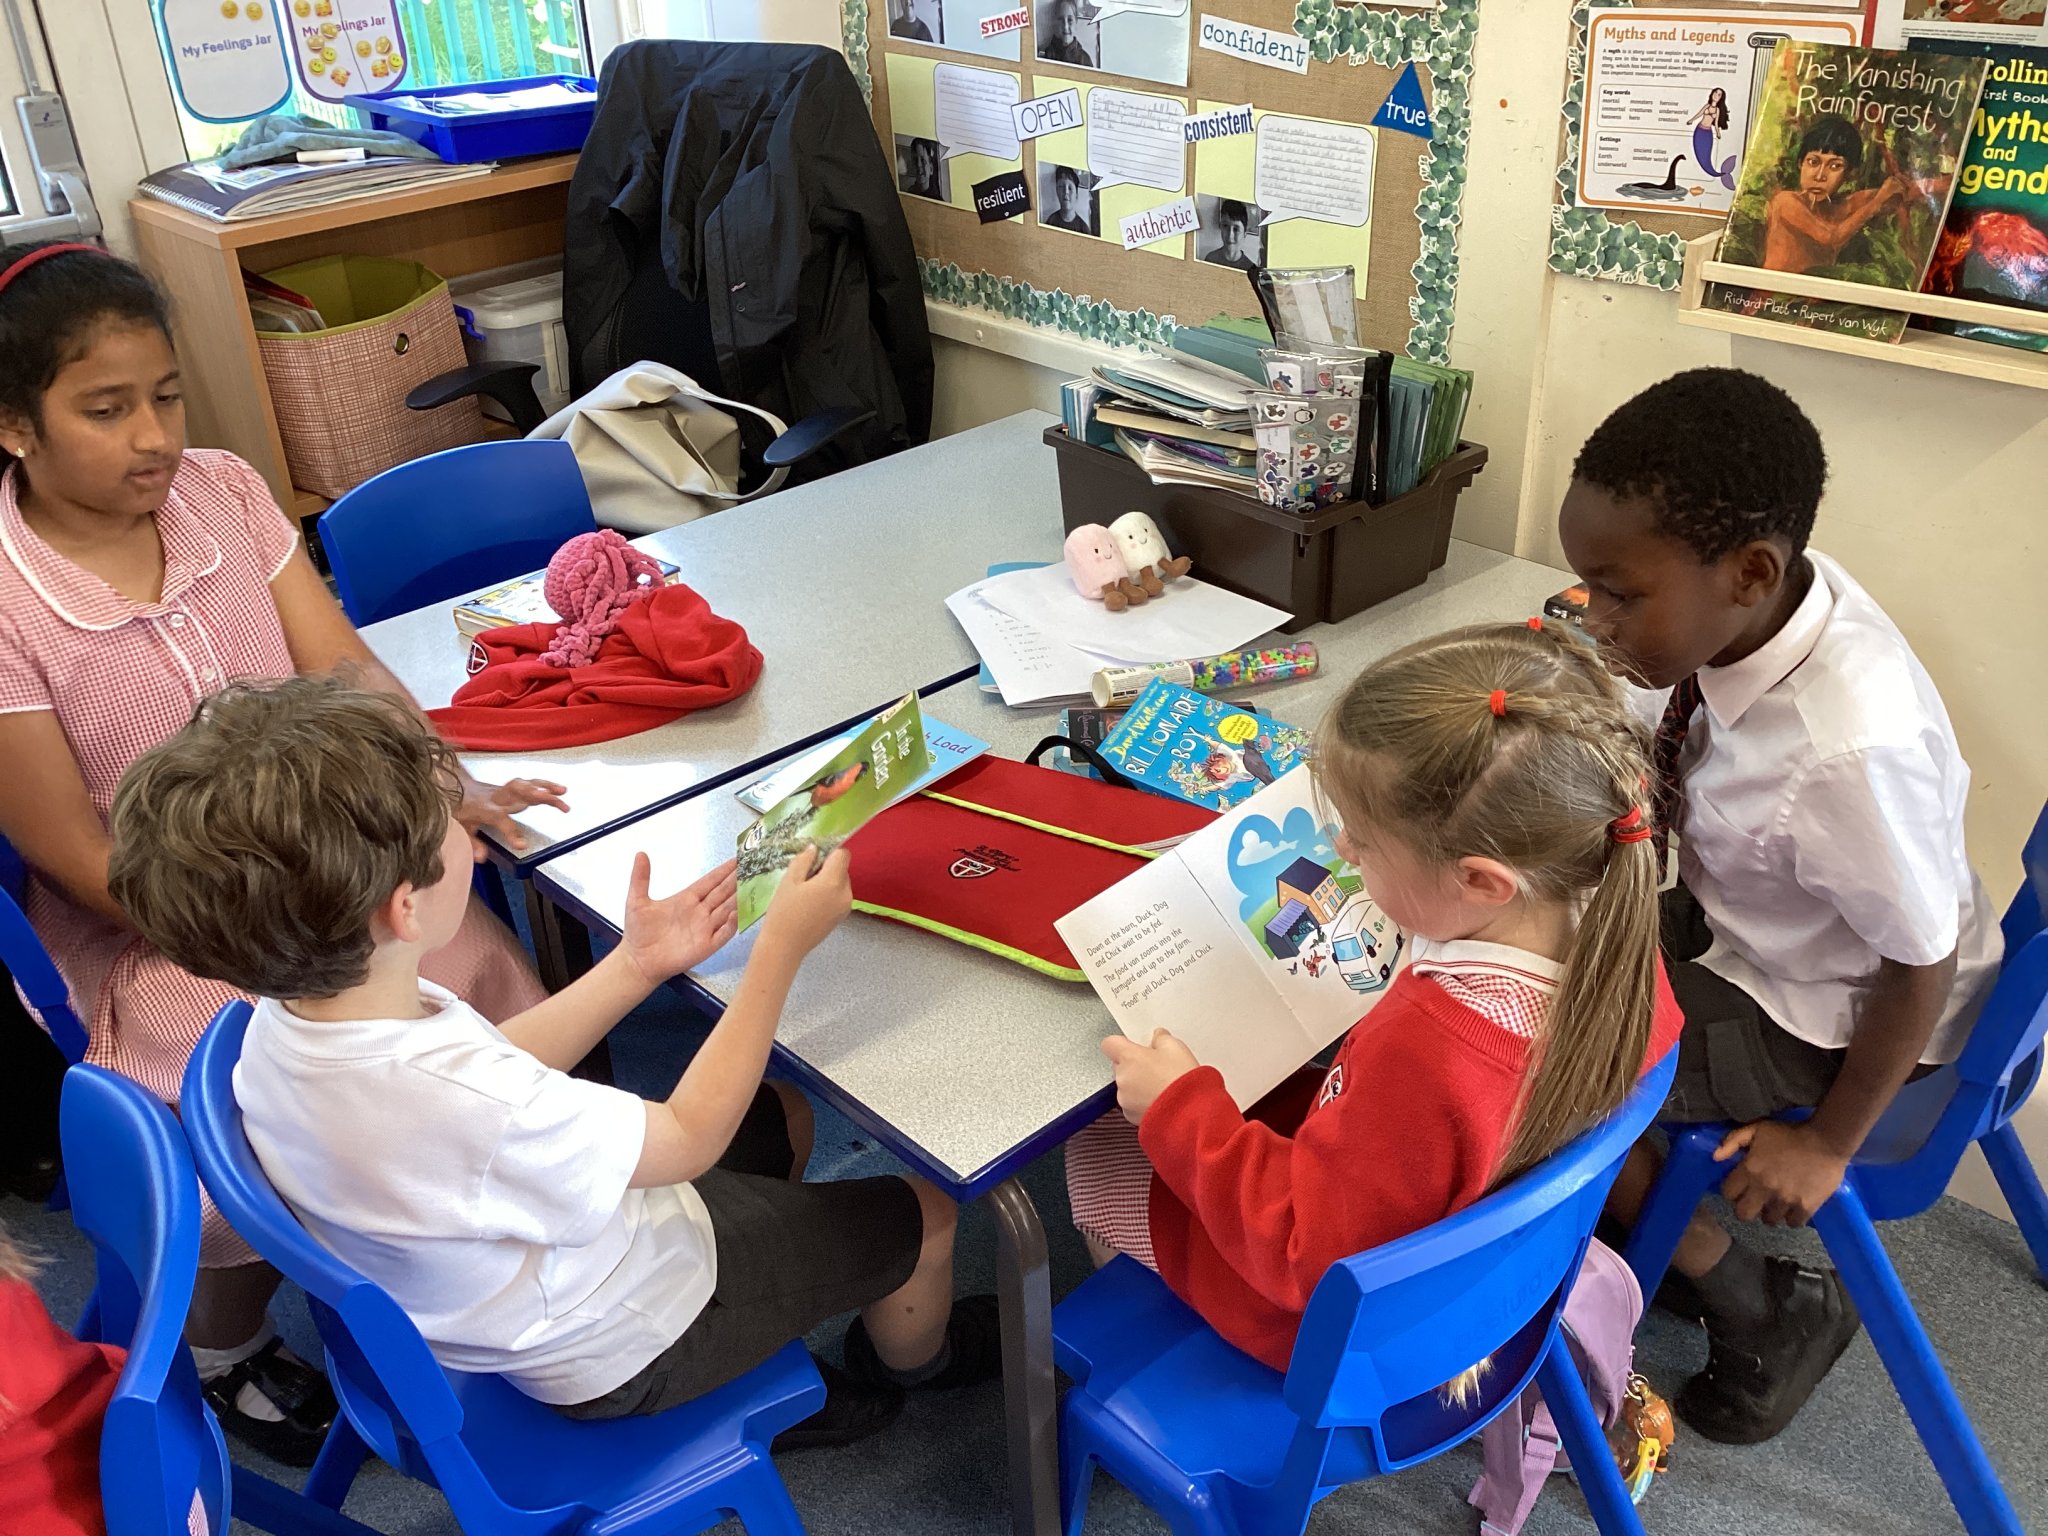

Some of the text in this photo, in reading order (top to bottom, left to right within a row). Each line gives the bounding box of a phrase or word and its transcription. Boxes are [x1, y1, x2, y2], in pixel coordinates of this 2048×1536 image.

[371, 16, 386, 27] Jar
[980, 10, 1029, 35] STRONG
[1604, 26, 1735, 45] Myths and Legends
[182, 34, 272, 58] My Feelings Jar
[1203, 23, 1306, 68] confident
[1795, 49, 1964, 118] The Vanishing
[1985, 58, 2048, 85] ollin
[1385, 94, 1427, 127] true
[1795, 85, 1937, 133] Rainforest
[1983, 88, 2008, 101] irst
[1020, 96, 1074, 133] OPEN
[1184, 107, 1254, 143] consistent
[1982, 146, 2018, 161] and
[1959, 163, 2048, 195] gend
[976, 184, 1026, 211] resilient
[1125, 204, 1193, 244] authentic
[1723, 290, 1888, 338] Richard Platt Rupert van Wyk
[870, 731, 895, 790] Garden
[932, 735, 973, 755] Load
[1171, 726, 1205, 760] BOY
[1087, 941, 1104, 956] Down
[1111, 931, 1121, 941] the
[1120, 922, 1138, 935] barn,
[1135, 910, 1155, 924] Duck,
[1153, 901, 1169, 912] Dog
[1096, 955, 1106, 968] and
[1105, 946, 1121, 960] Chick
[1122, 938, 1135, 950] wait
[1135, 933, 1142, 941] to
[1142, 927, 1151, 935] be
[1104, 927, 1182, 983] The food van zooms into the
[1111, 973, 1137, 998] farmyard
[1136, 965, 1148, 978] and
[1149, 961, 1157, 971] up
[1164, 948, 1175, 958] the
[1142, 985, 1152, 1000] yell
[1151, 975, 1171, 990] Duck,
[1169, 964, 1185, 977] Dog
[1184, 955, 1196, 967] and
